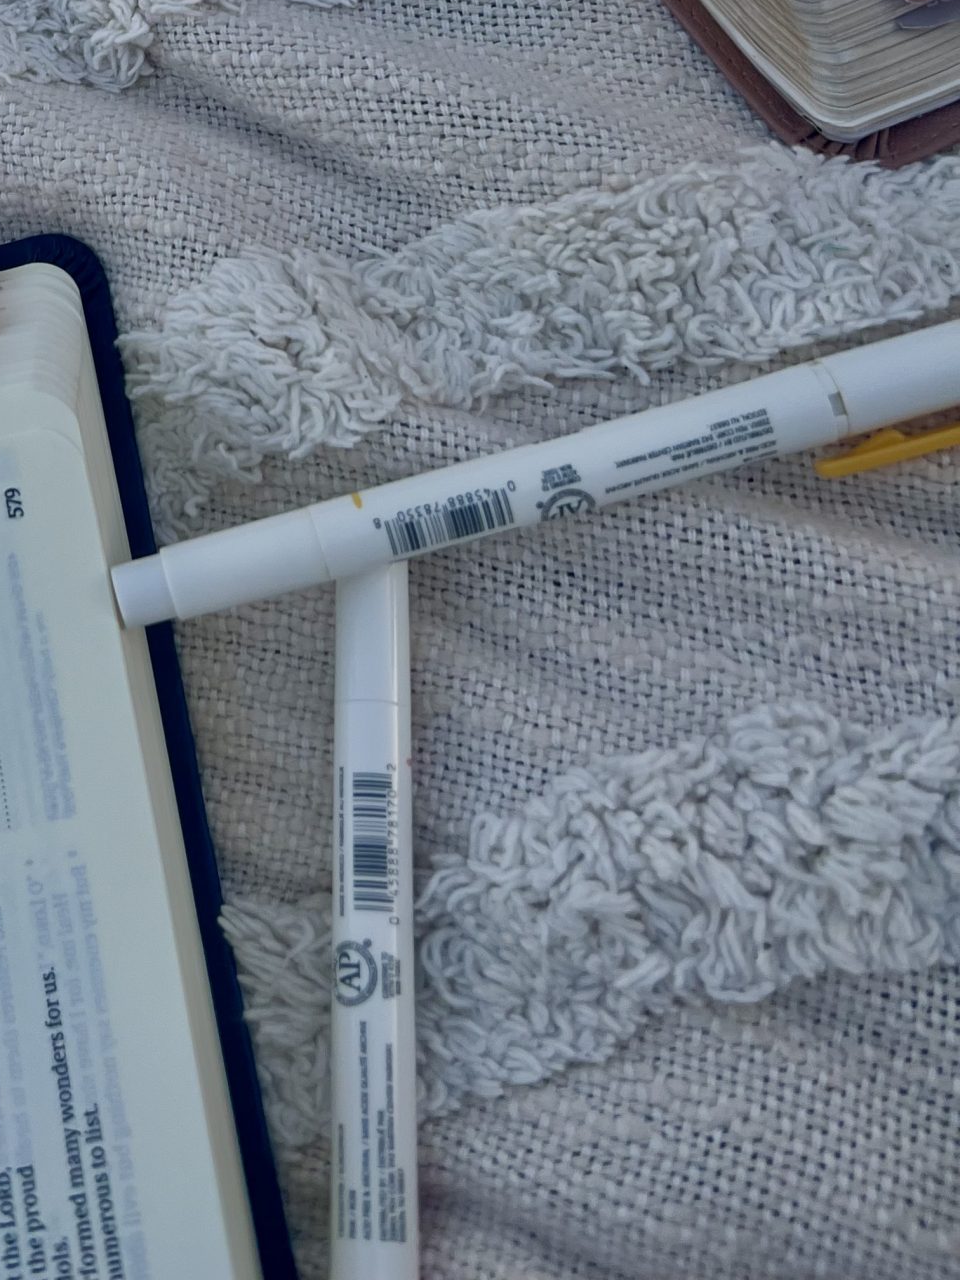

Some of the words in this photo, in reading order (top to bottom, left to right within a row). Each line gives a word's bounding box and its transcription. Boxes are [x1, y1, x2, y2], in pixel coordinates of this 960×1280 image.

[4, 487, 24, 519] 579
[397, 501, 440, 523] 78350
[447, 488, 491, 507] 45888
[387, 790, 398, 837] 78170
[387, 848, 399, 896] 45888
[43, 966, 58, 995] us.
[45, 998, 63, 1029] for
[51, 1031, 75, 1124] wonders
[84, 1102, 104, 1143] list.
[62, 1127, 86, 1188] many
[88, 1145, 108, 1169] to
[16, 1164, 46, 1233] proud
[0, 1231, 22, 1269] the
[24, 1235, 47, 1274] the
[67, 1192, 98, 1280] formed
